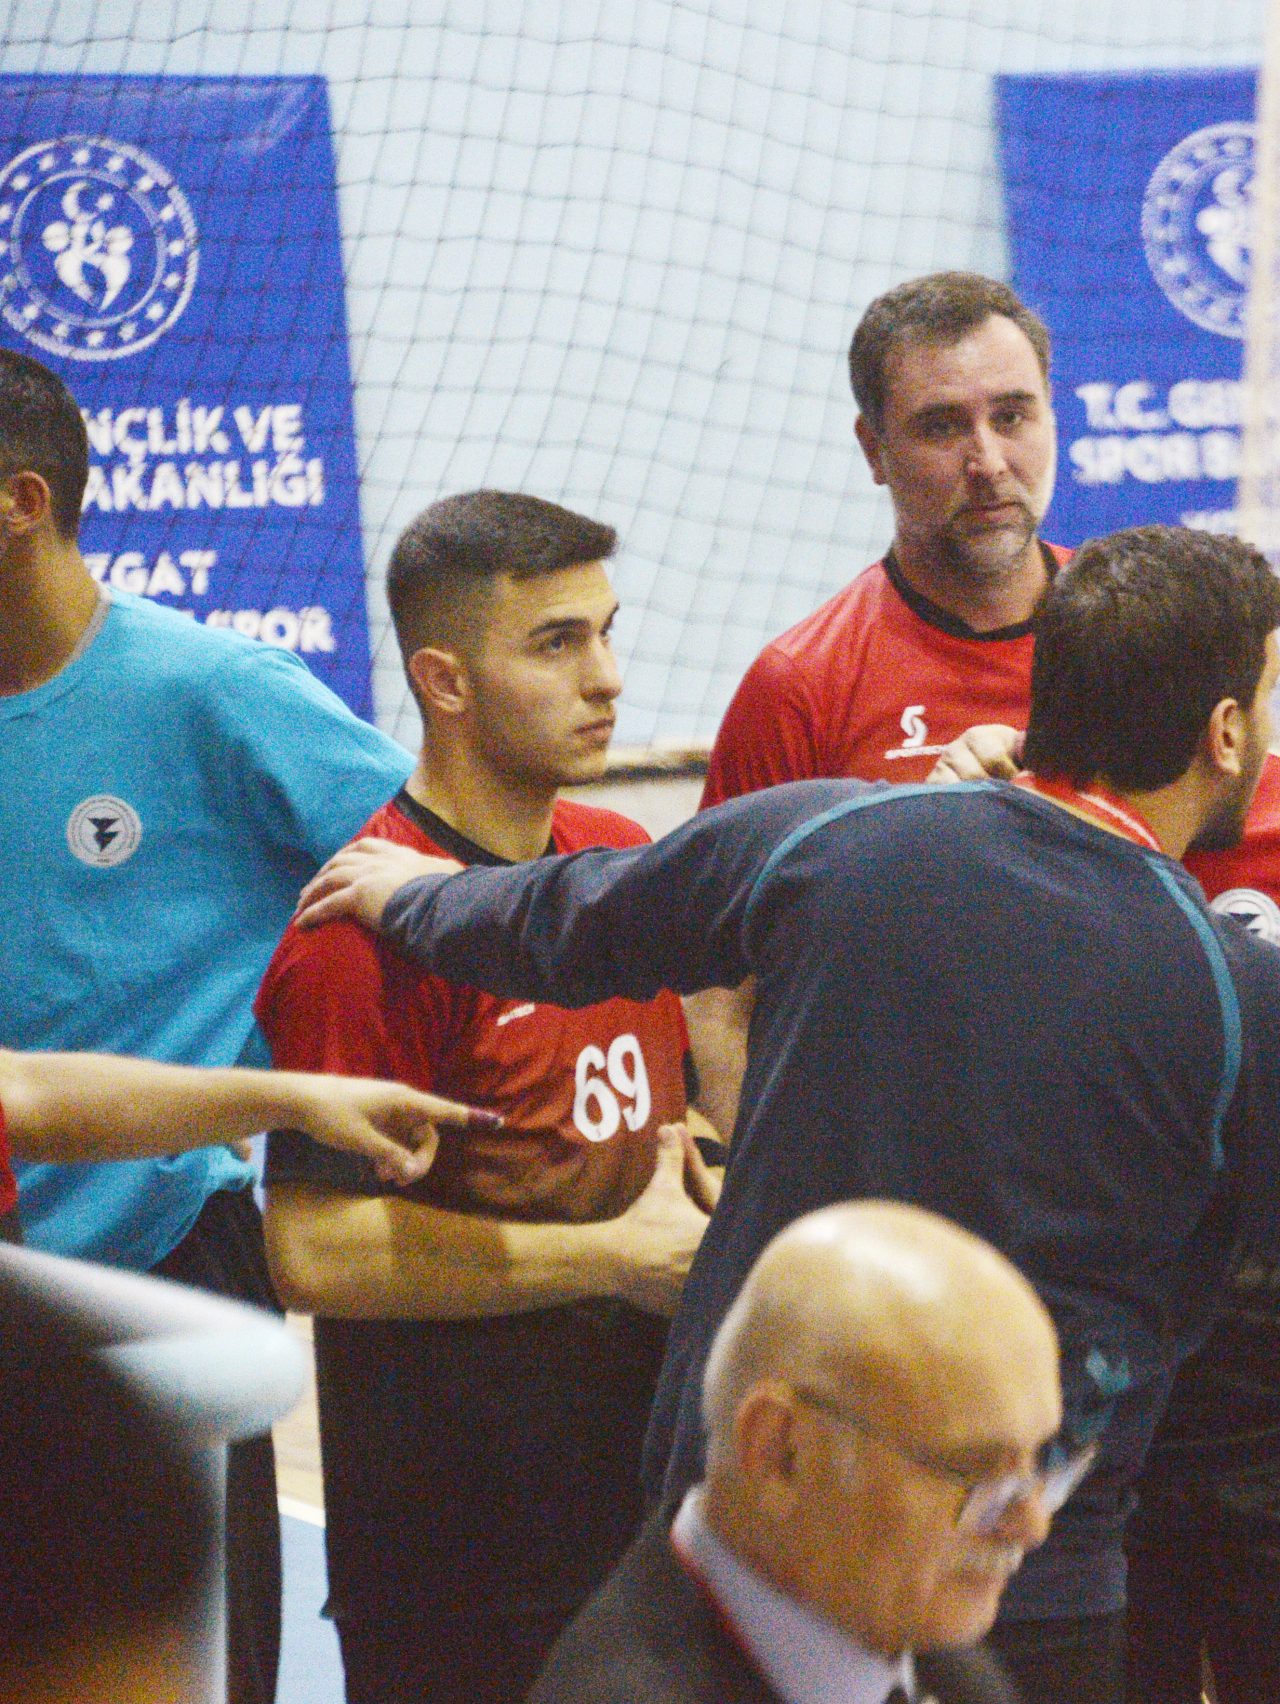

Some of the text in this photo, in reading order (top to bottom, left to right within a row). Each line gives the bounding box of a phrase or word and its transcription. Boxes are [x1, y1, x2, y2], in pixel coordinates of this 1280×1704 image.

[80, 398, 304, 467] NÇLİK VE
[81, 452, 325, 512] AKANLIĞI
[84, 550, 217, 597] ZGAT
[572, 1033, 652, 1143] 69
